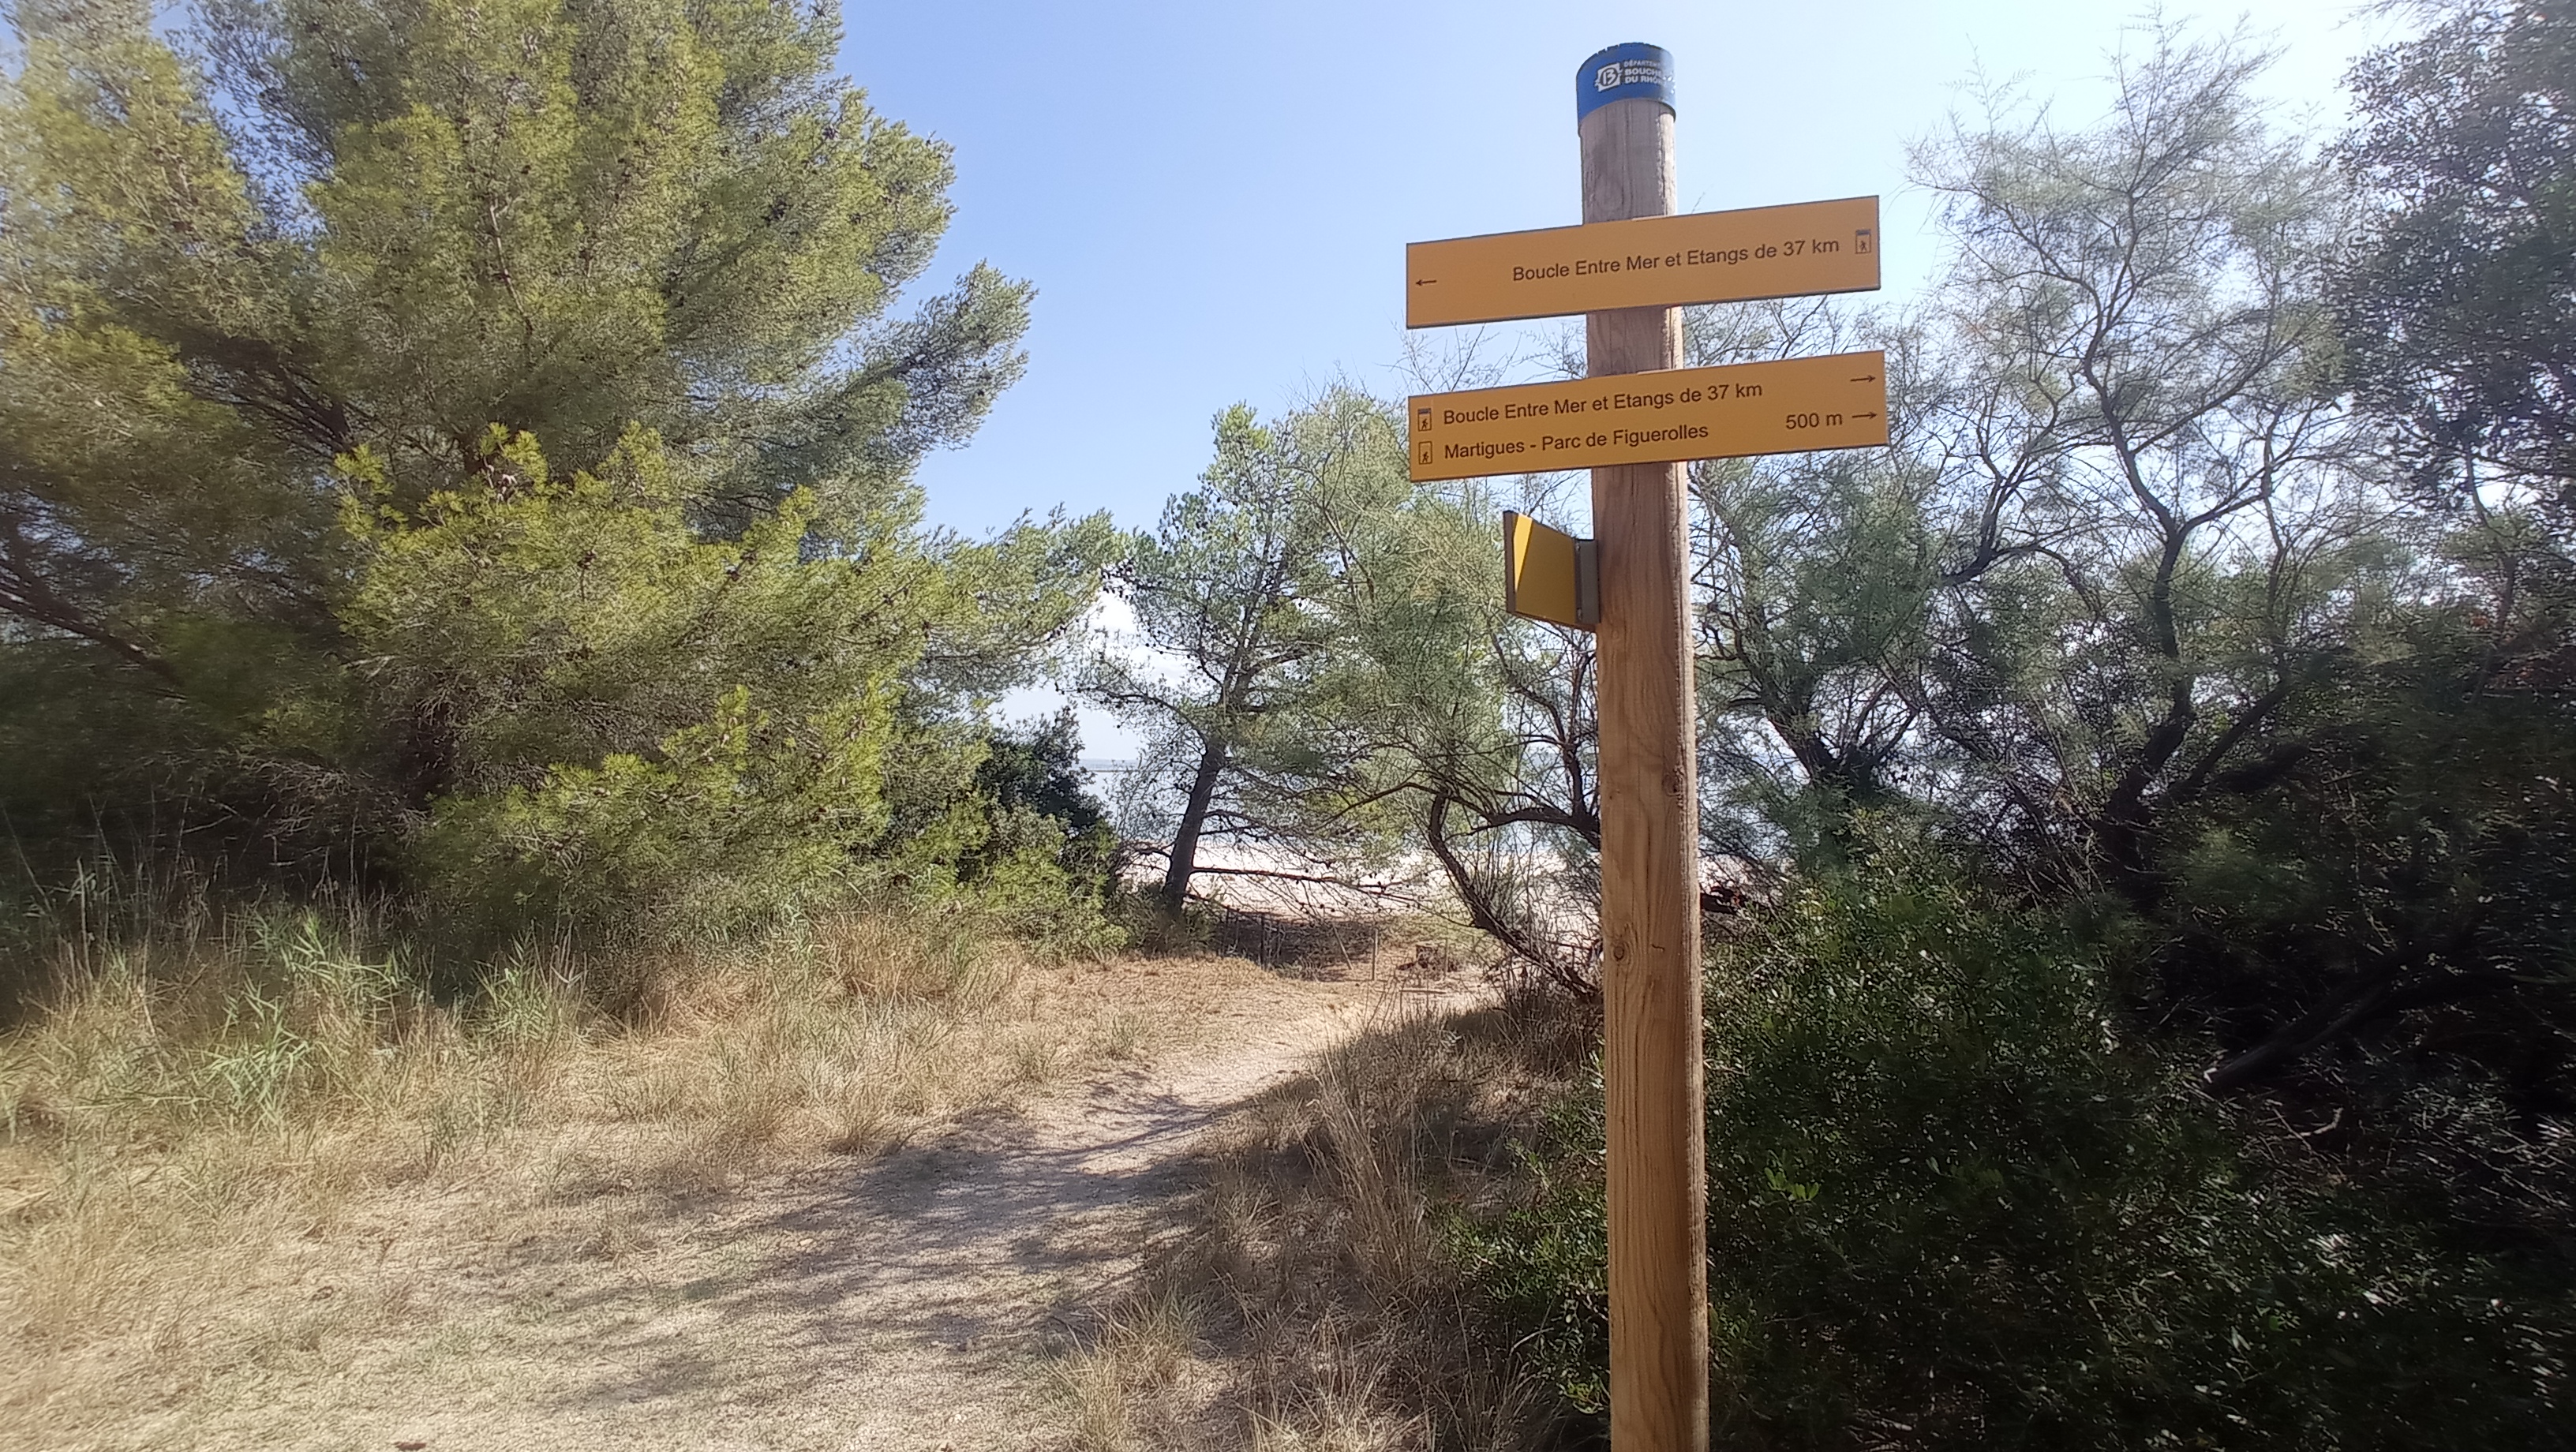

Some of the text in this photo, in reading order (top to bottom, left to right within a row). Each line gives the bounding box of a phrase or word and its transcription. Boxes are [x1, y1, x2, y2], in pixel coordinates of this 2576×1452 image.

[1513, 238, 1840, 282] Boucle Entre Mer et Etangs de 37 km
[1443, 383, 1762, 425] Boucle Entre Mer et Etangs de 37 km
[1444, 441, 1526, 459] Martigues
[1541, 436, 1582, 451] Parc
[1586, 432, 1608, 447] de
[1613, 424, 1709, 447] Figuerolles
[1785, 412, 1820, 430] 500
[1825, 414, 1843, 427] m
